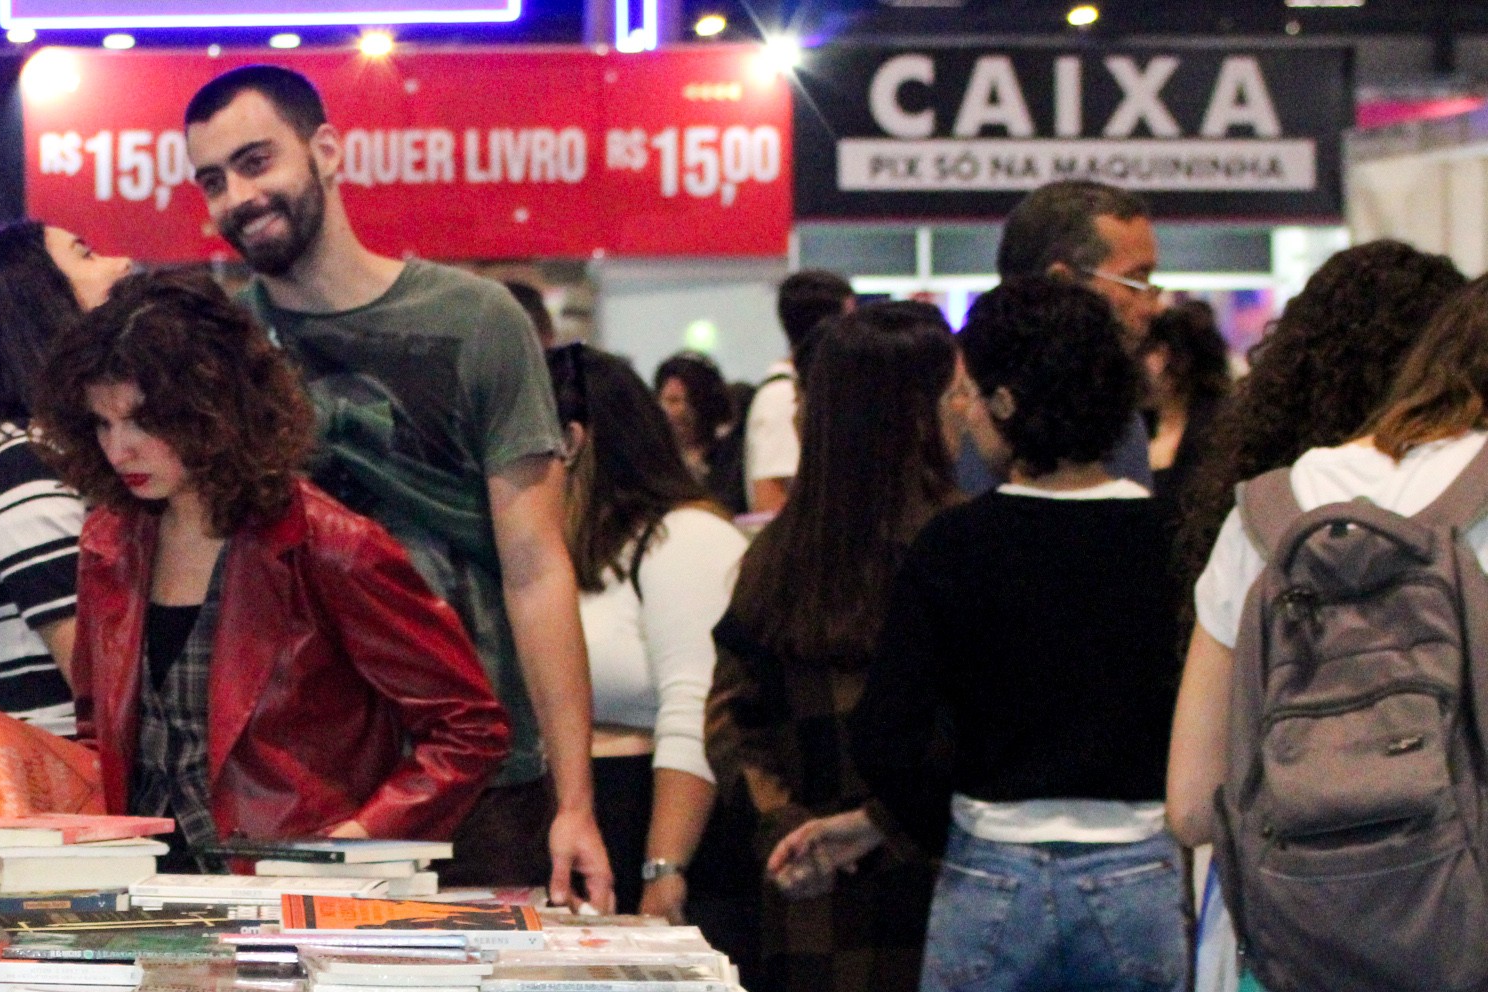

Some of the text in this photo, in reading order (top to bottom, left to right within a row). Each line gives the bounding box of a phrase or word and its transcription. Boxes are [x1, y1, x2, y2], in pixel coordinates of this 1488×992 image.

[868, 52, 1282, 139] CAIXA
[38, 130, 84, 177] R$
[334, 126, 587, 188] QUER LIVRO
[605, 124, 780, 206] R$ 15,00
[870, 150, 1286, 182] PIX SÓ NA MAQUININHA
